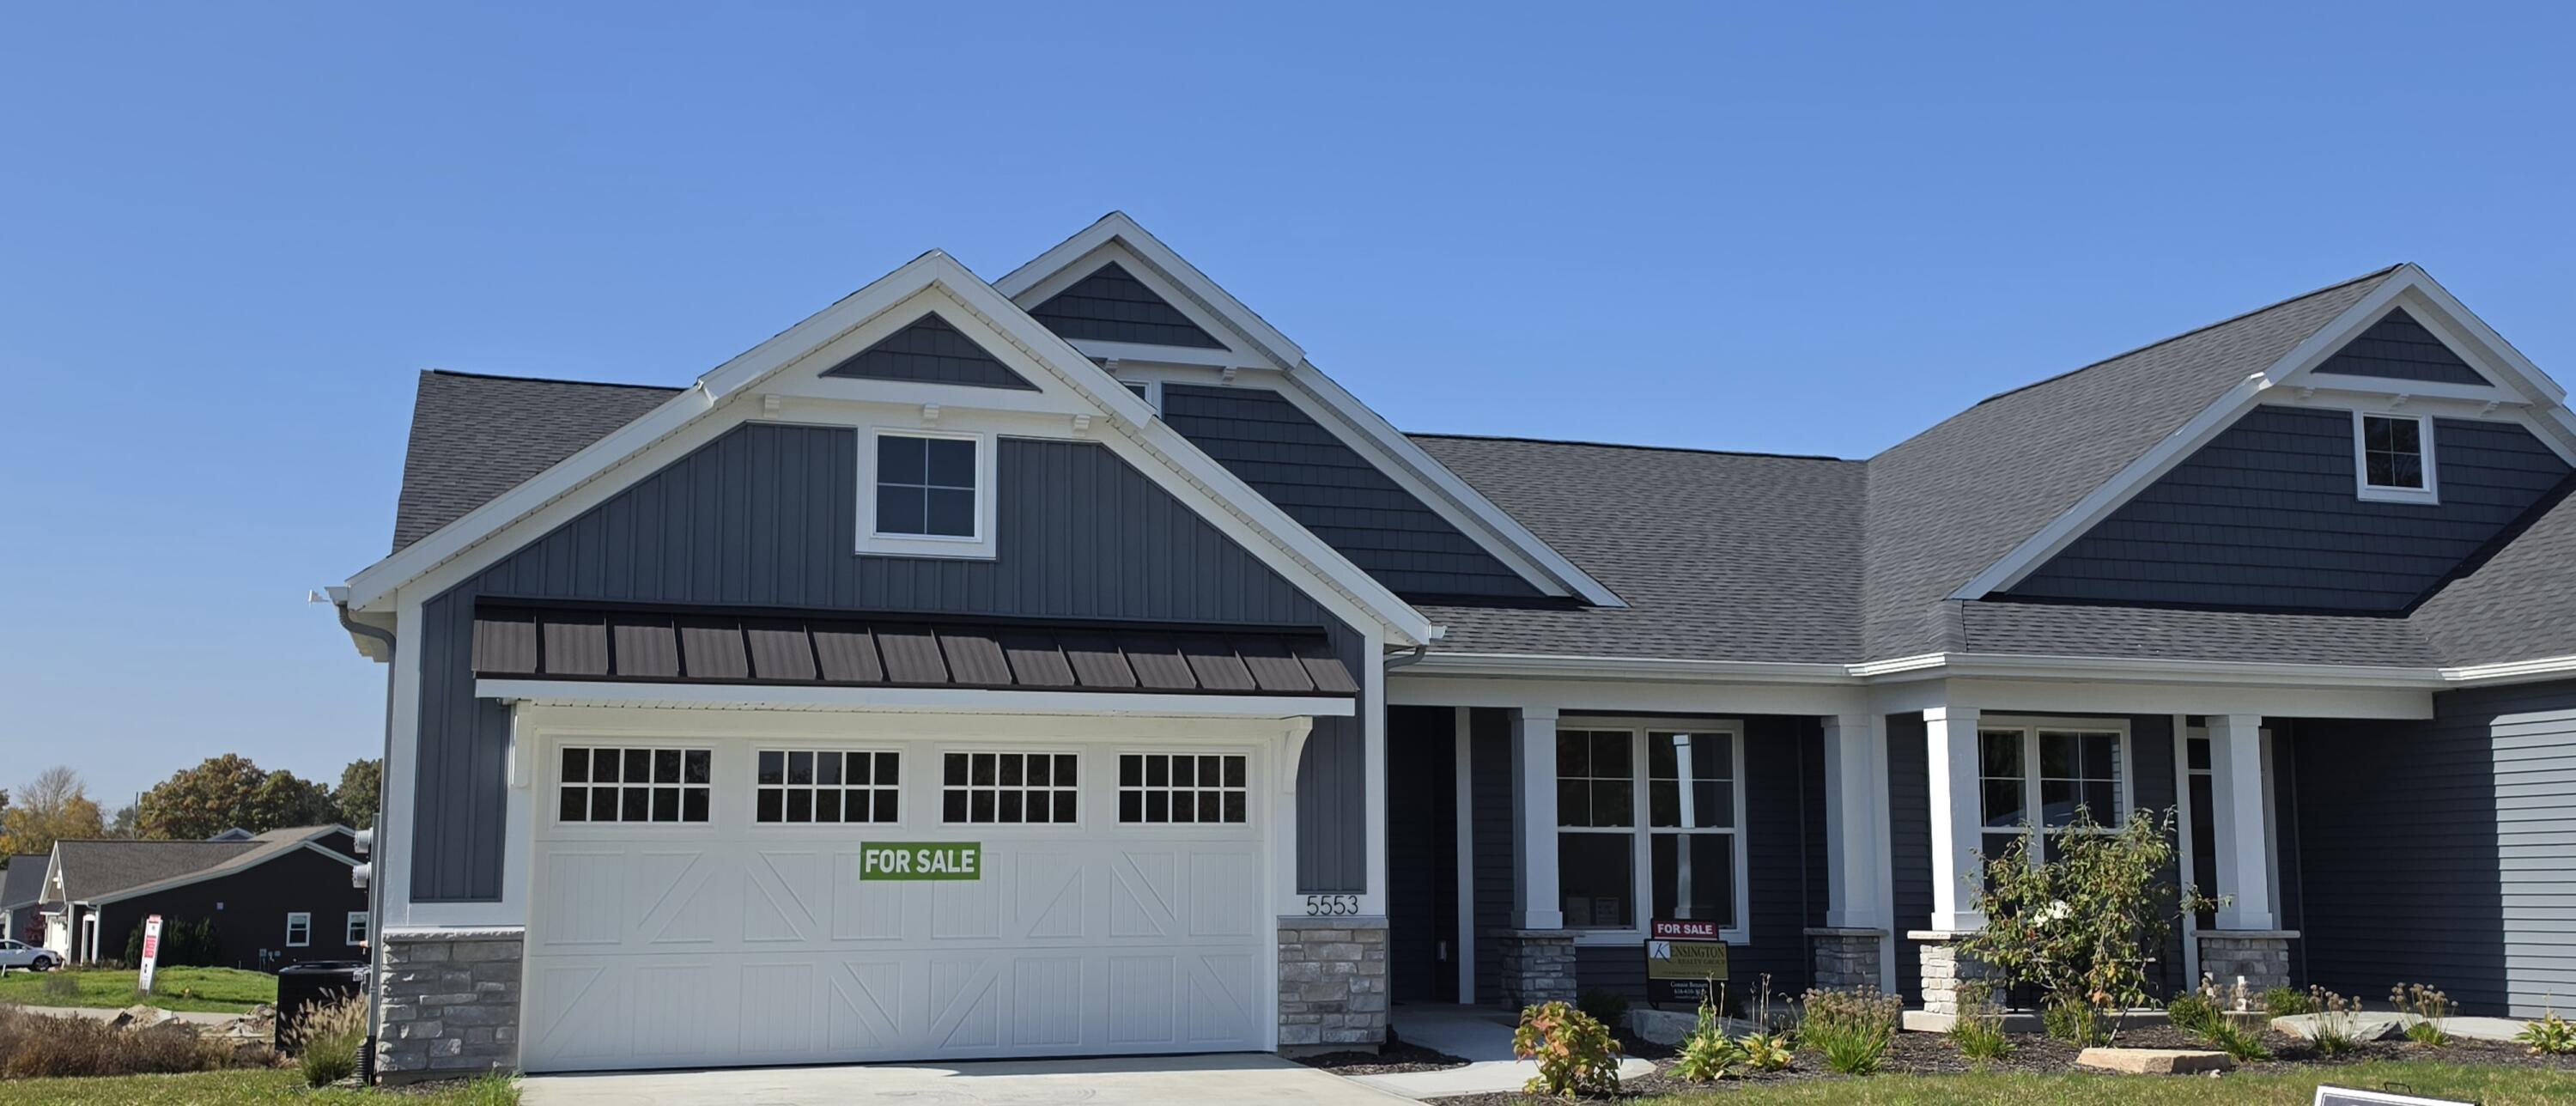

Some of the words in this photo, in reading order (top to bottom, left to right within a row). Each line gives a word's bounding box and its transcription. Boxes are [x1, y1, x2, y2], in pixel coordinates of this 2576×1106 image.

[866, 849, 911, 873] FOR
[916, 849, 975, 873] SALE
[1307, 895, 1358, 915] 5553
[1657, 924, 1680, 934] FOR
[1684, 924, 1713, 934] SALE
[1654, 943, 1725, 963] KENSINGTON
